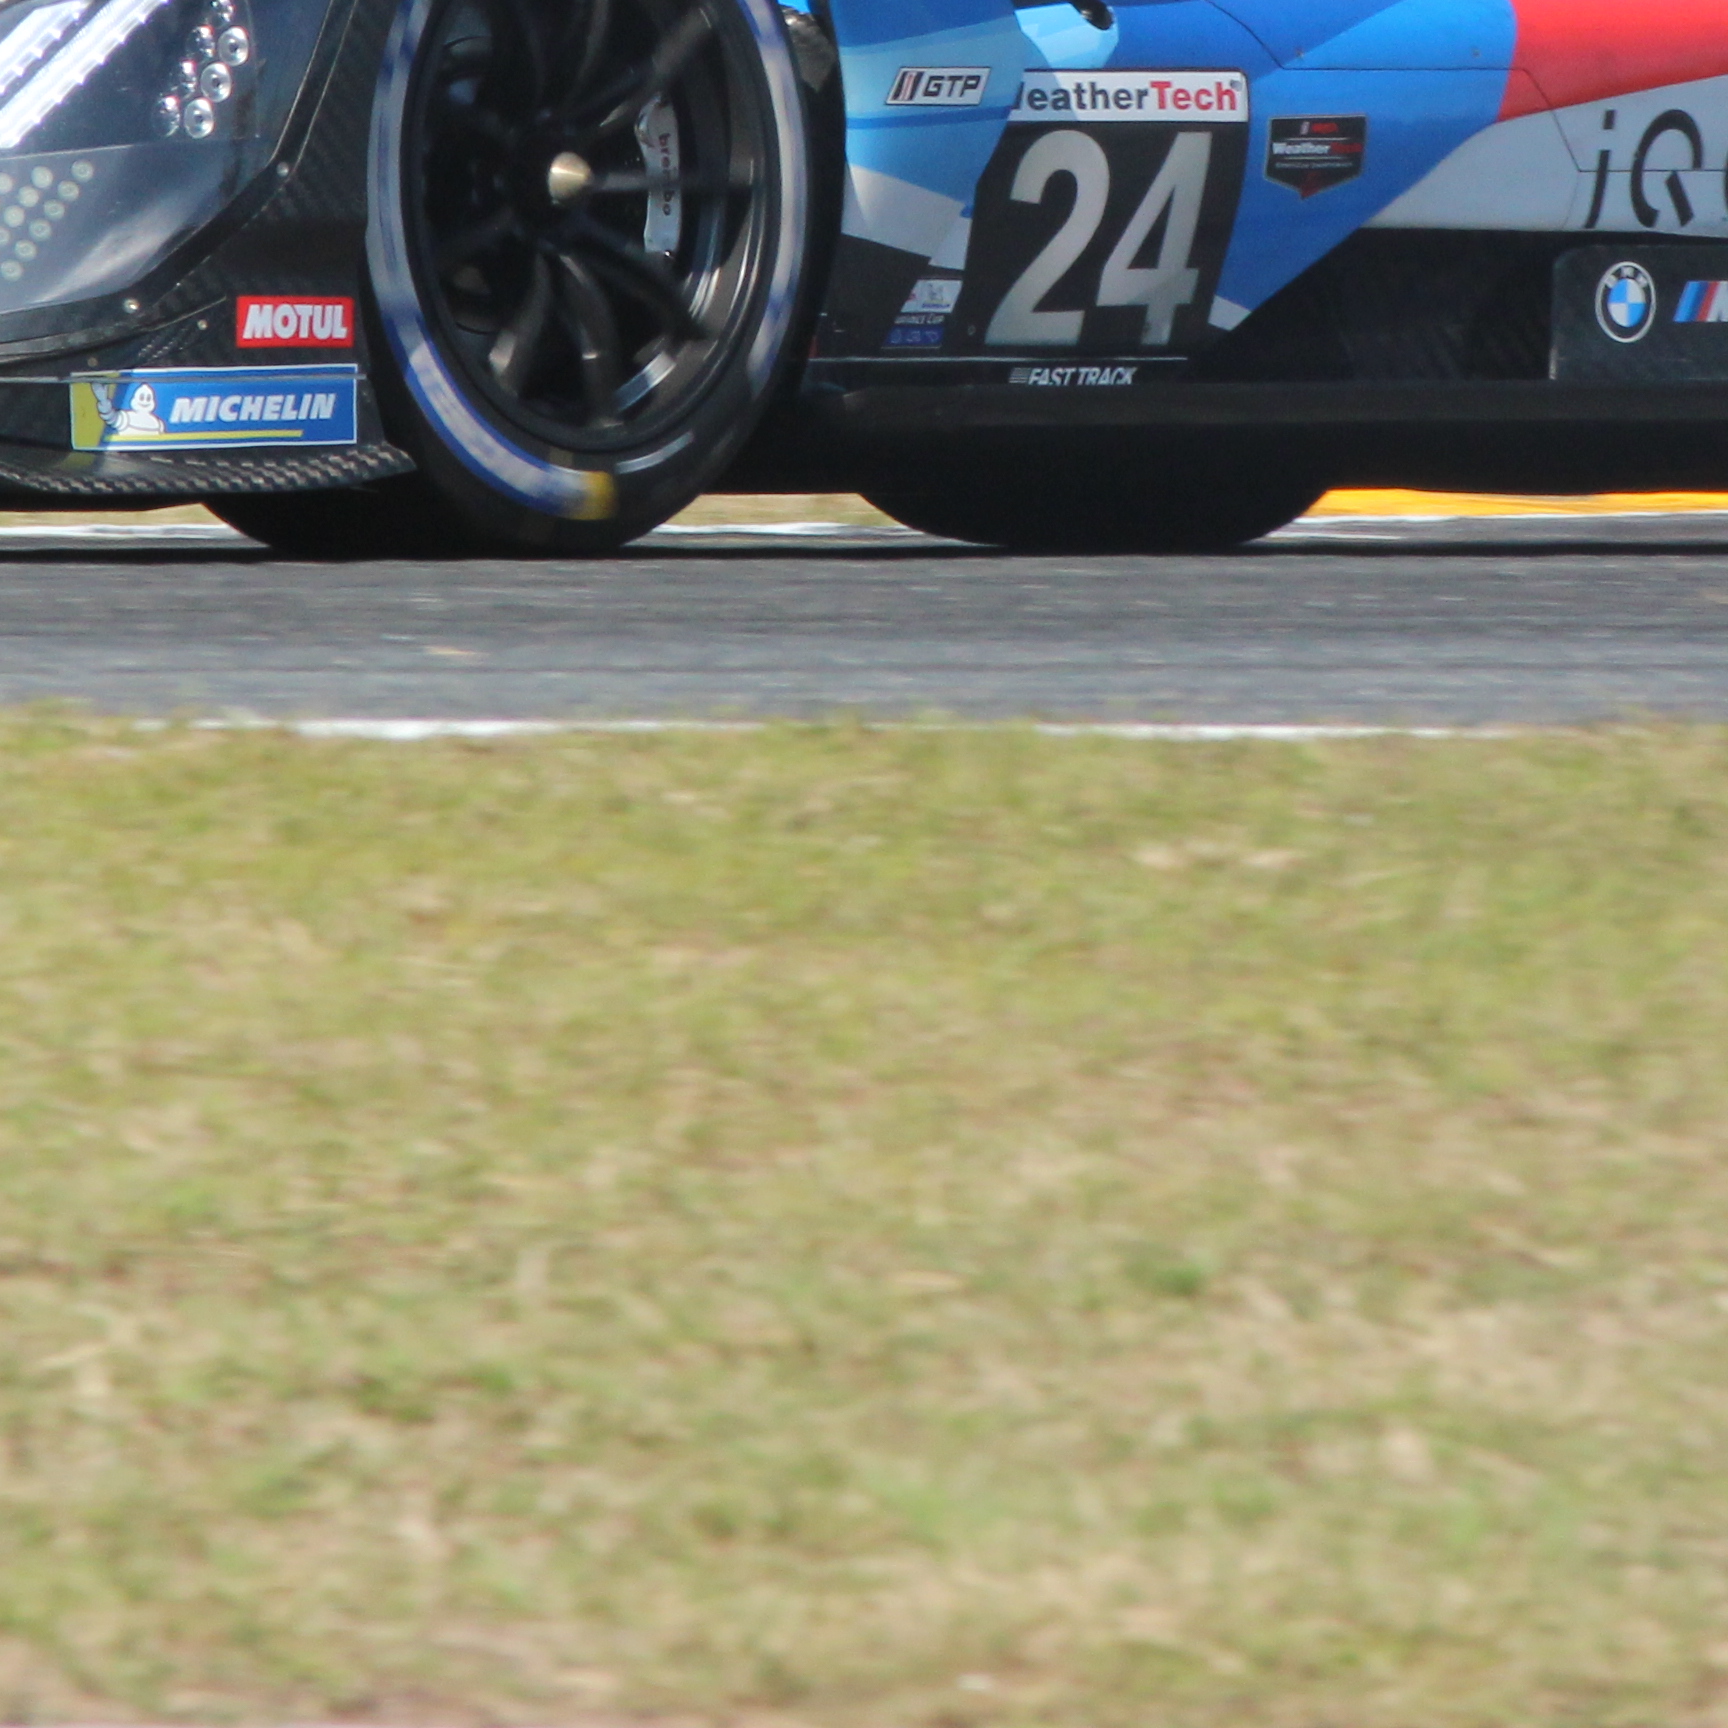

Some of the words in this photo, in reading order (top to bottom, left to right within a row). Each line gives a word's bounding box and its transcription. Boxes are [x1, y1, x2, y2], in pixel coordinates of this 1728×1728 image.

[921, 73, 981, 98] GTP
[984, 129, 1214, 347] 24
[242, 303, 349, 340] MOTUL
[1027, 367, 1079, 386] FAST
[1076, 366, 1138, 386] TRACK
[169, 392, 338, 424] MICHELIN
